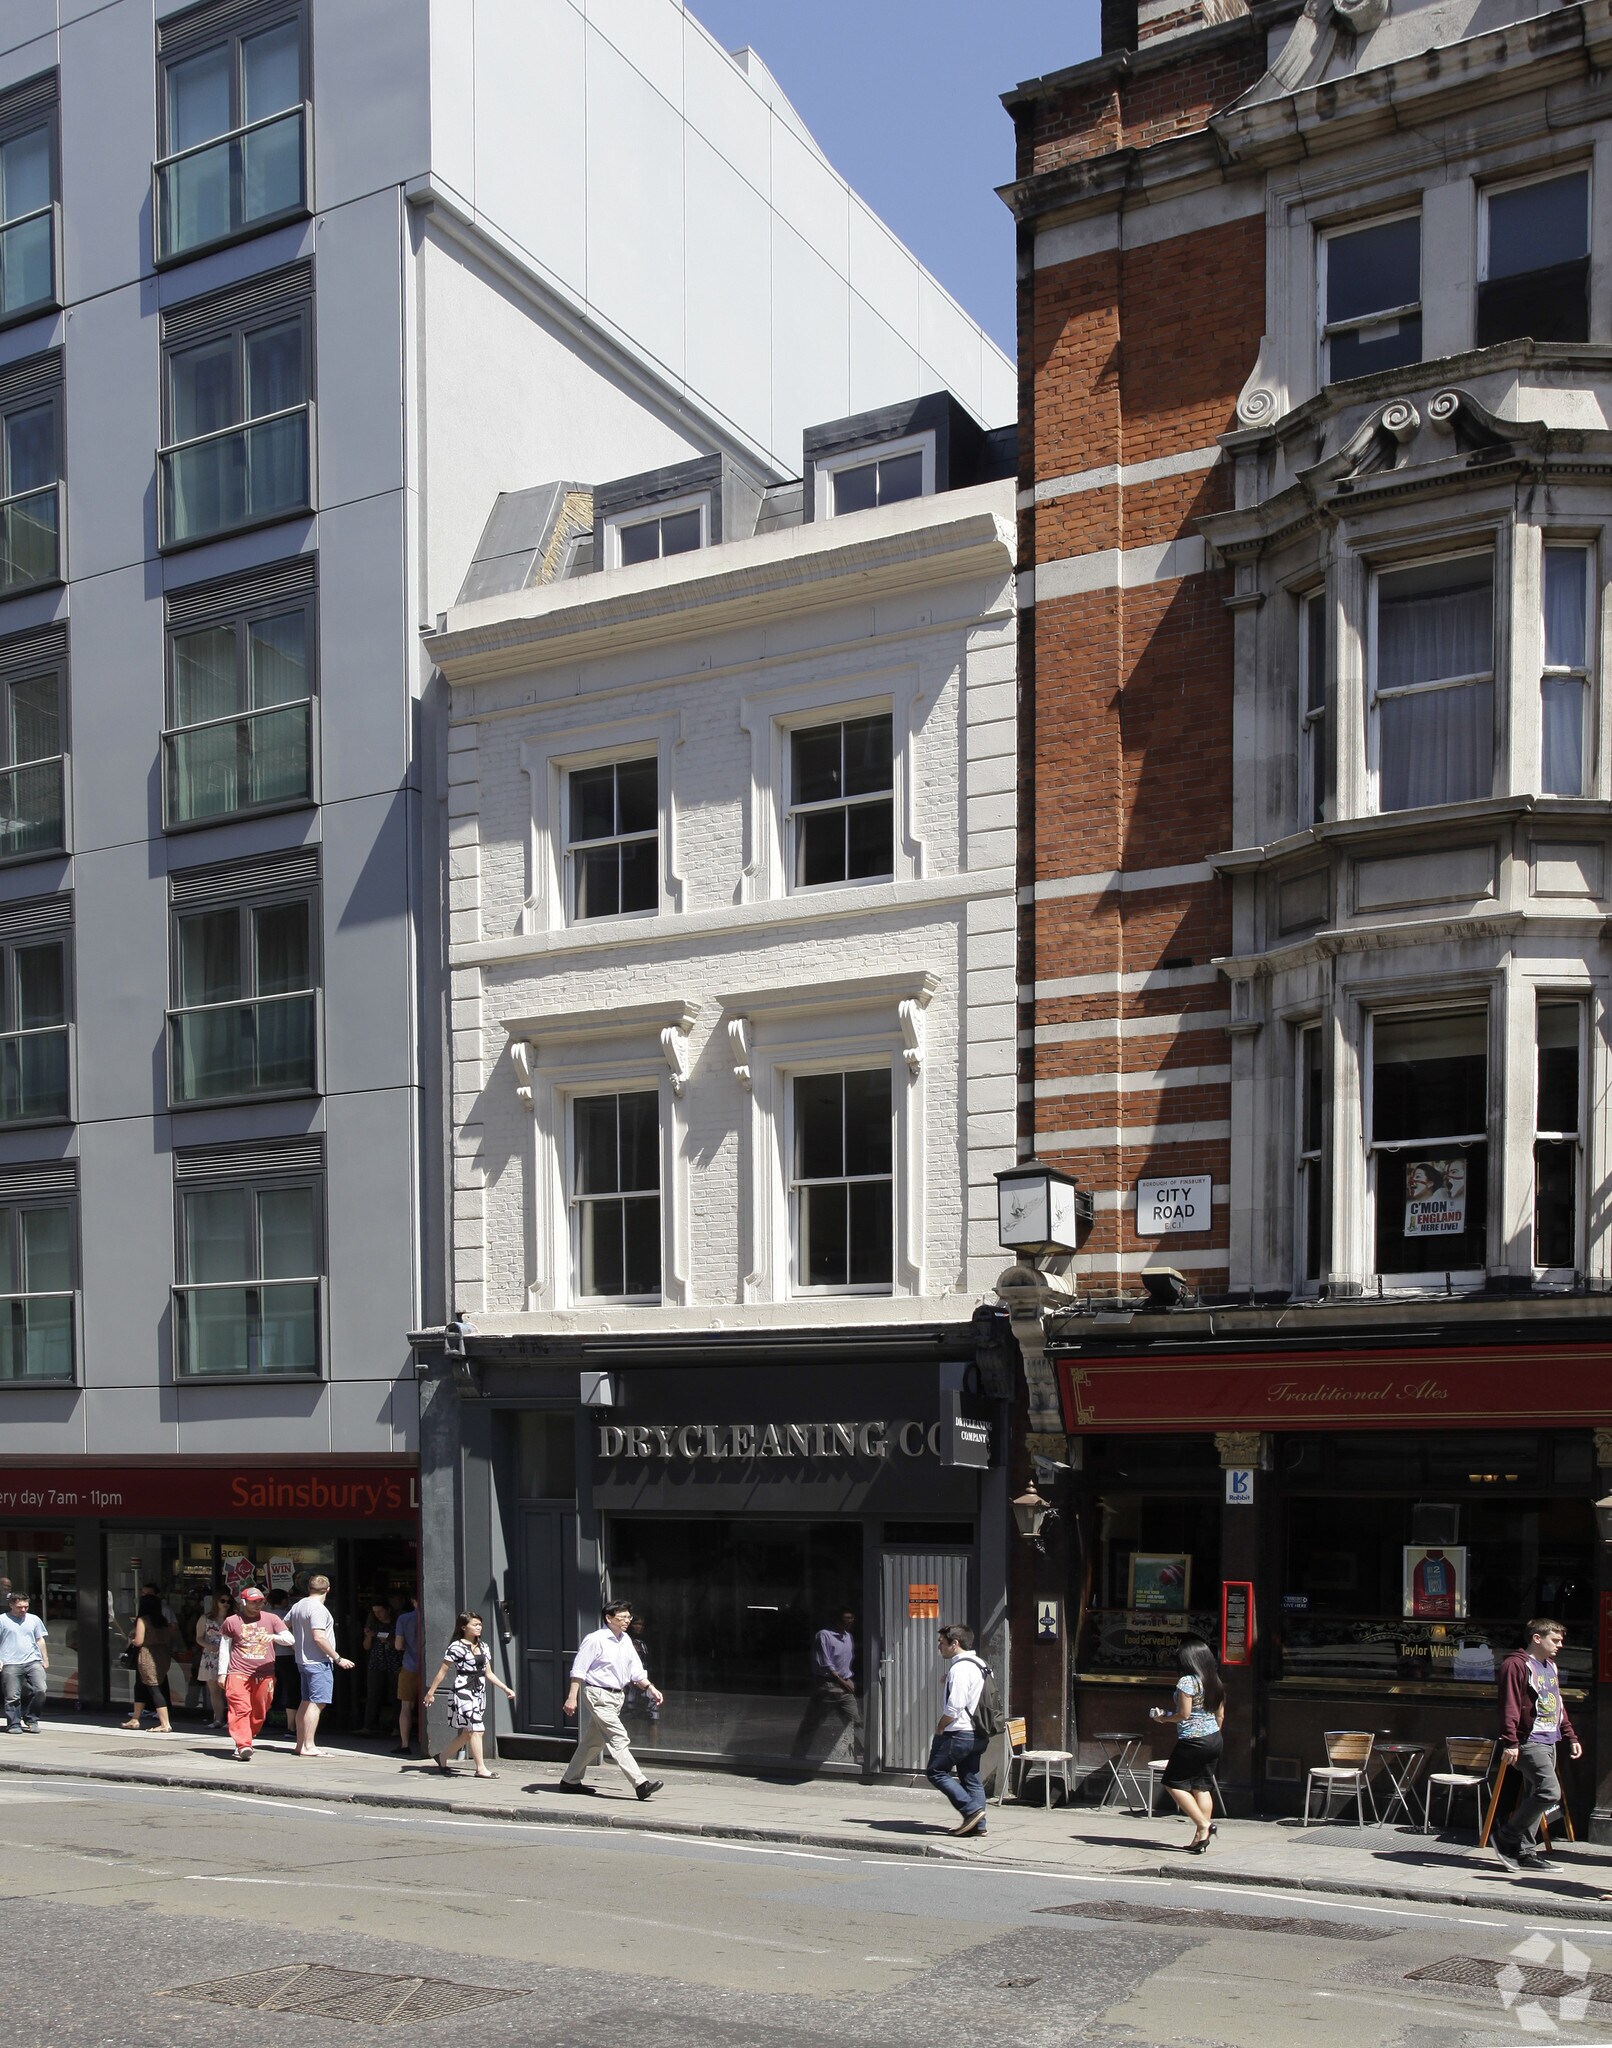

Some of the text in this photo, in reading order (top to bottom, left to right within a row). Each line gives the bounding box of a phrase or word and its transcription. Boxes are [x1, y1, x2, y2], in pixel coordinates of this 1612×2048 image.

[1156, 1187, 1192, 1203] CITY
[1153, 1204, 1195, 1220] ROAD
[1411, 1201, 1447, 1214] C'MON
[1418, 1212, 1461, 1224] ENGLAND
[1267, 1379, 1449, 1402] Traditional Ales
[597, 1421, 889, 1458] DRYCLEANING
[960, 1430, 987, 1444] COMPANY
[20, 1489, 45, 1508] day
[47, 1489, 78, 1505] 7am
[90, 1489, 122, 1508] 11pm
[231, 1476, 401, 1515] Sainsbury's
[271, 1565, 292, 1574] WIN
[1124, 1634, 1182, 1647] Food Served Daily
[1400, 1644, 1428, 1657] Taylor
